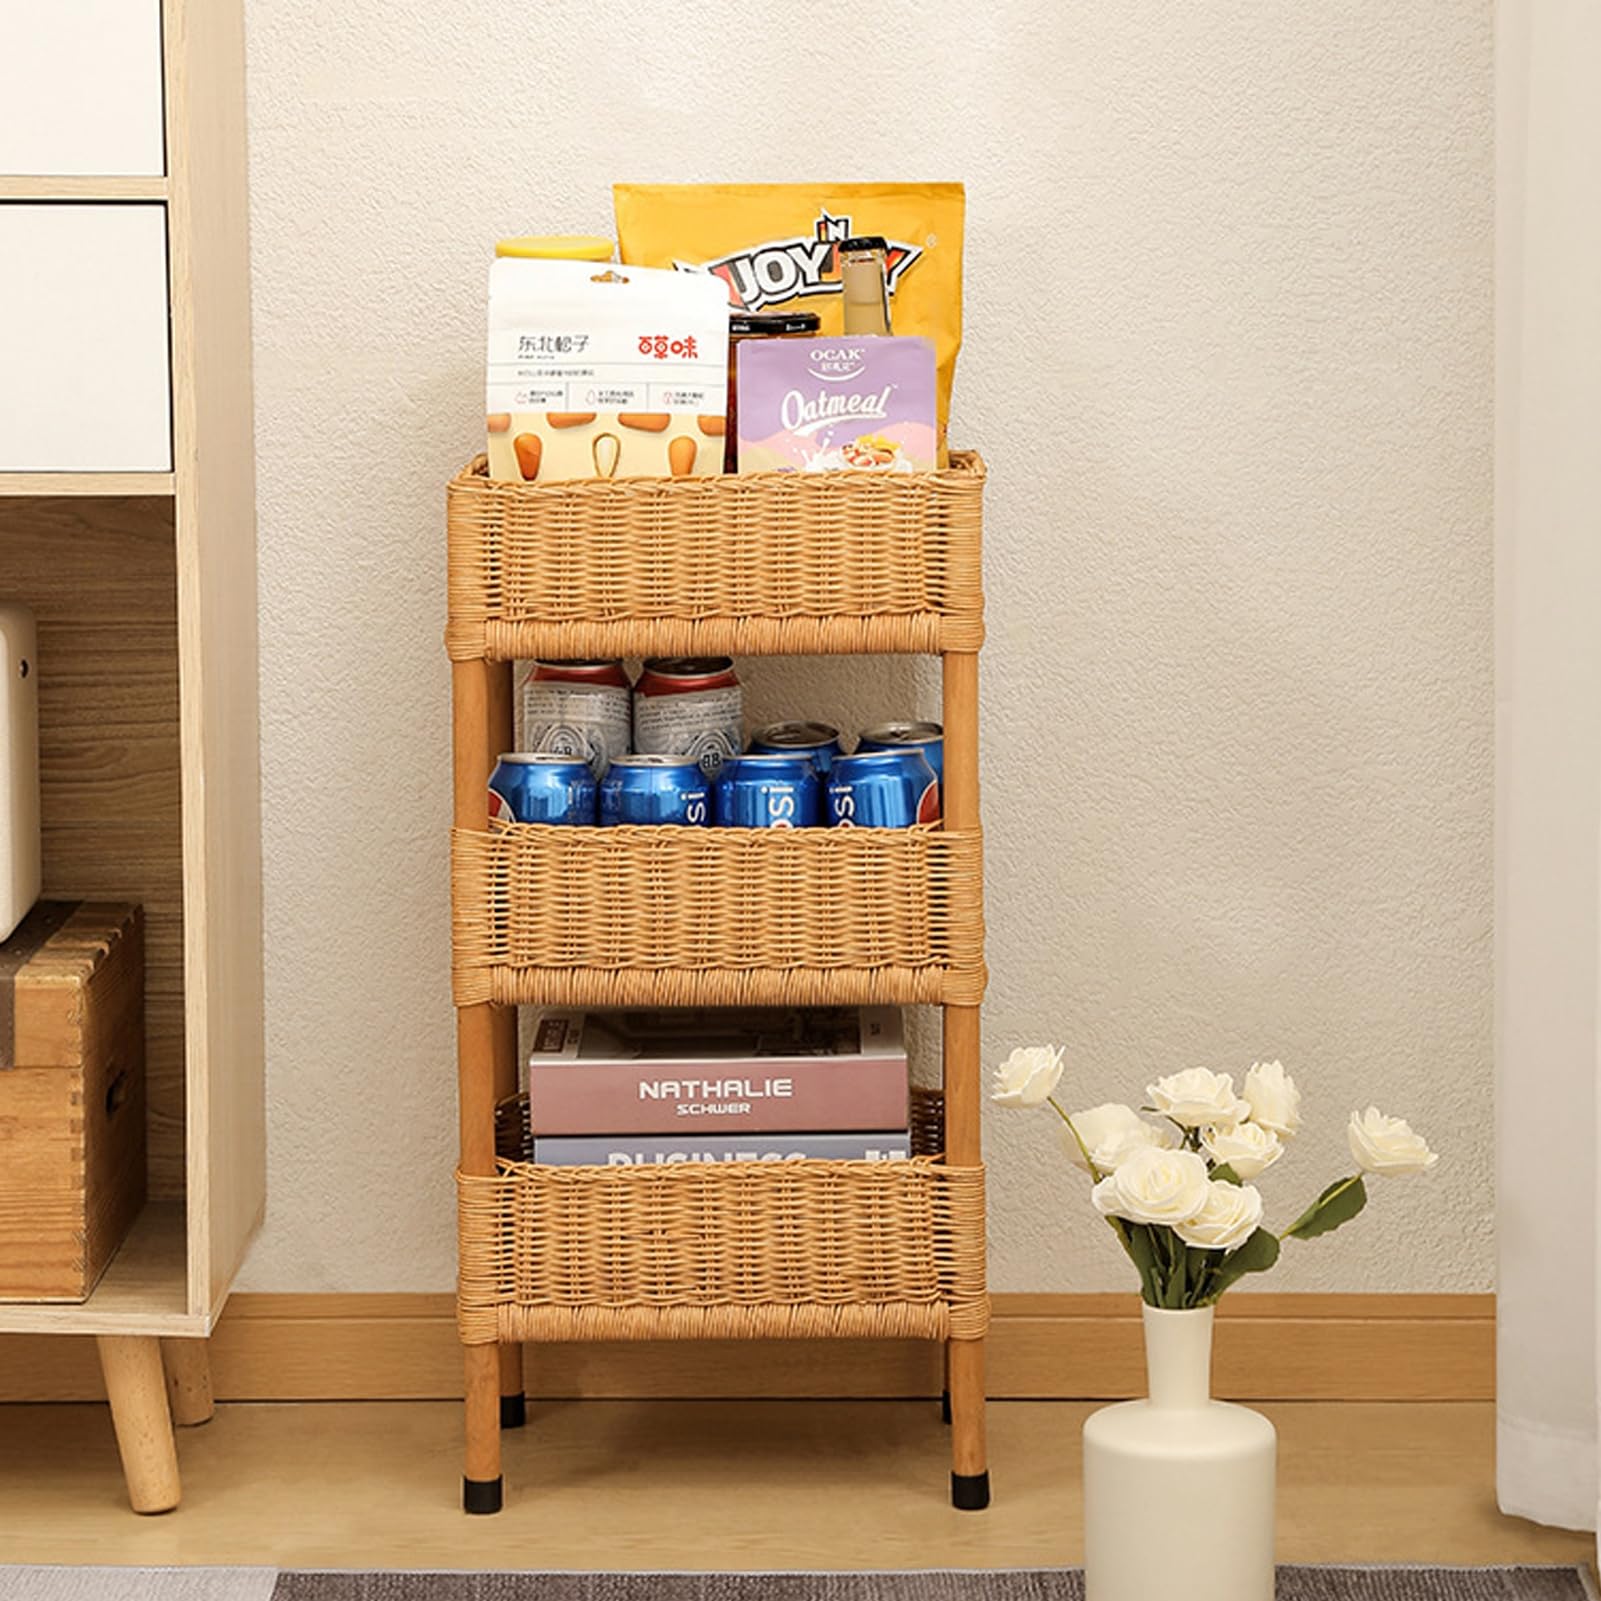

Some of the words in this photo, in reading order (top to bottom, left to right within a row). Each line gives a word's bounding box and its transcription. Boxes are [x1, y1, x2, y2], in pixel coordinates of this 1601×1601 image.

[638, 335, 698, 359] 百草味
[809, 348, 861, 362] OCAK
[781, 386, 891, 430] Oatmeal
[638, 1078, 793, 1100] NATHALIE
[676, 1102, 751, 1116] SCHWER
